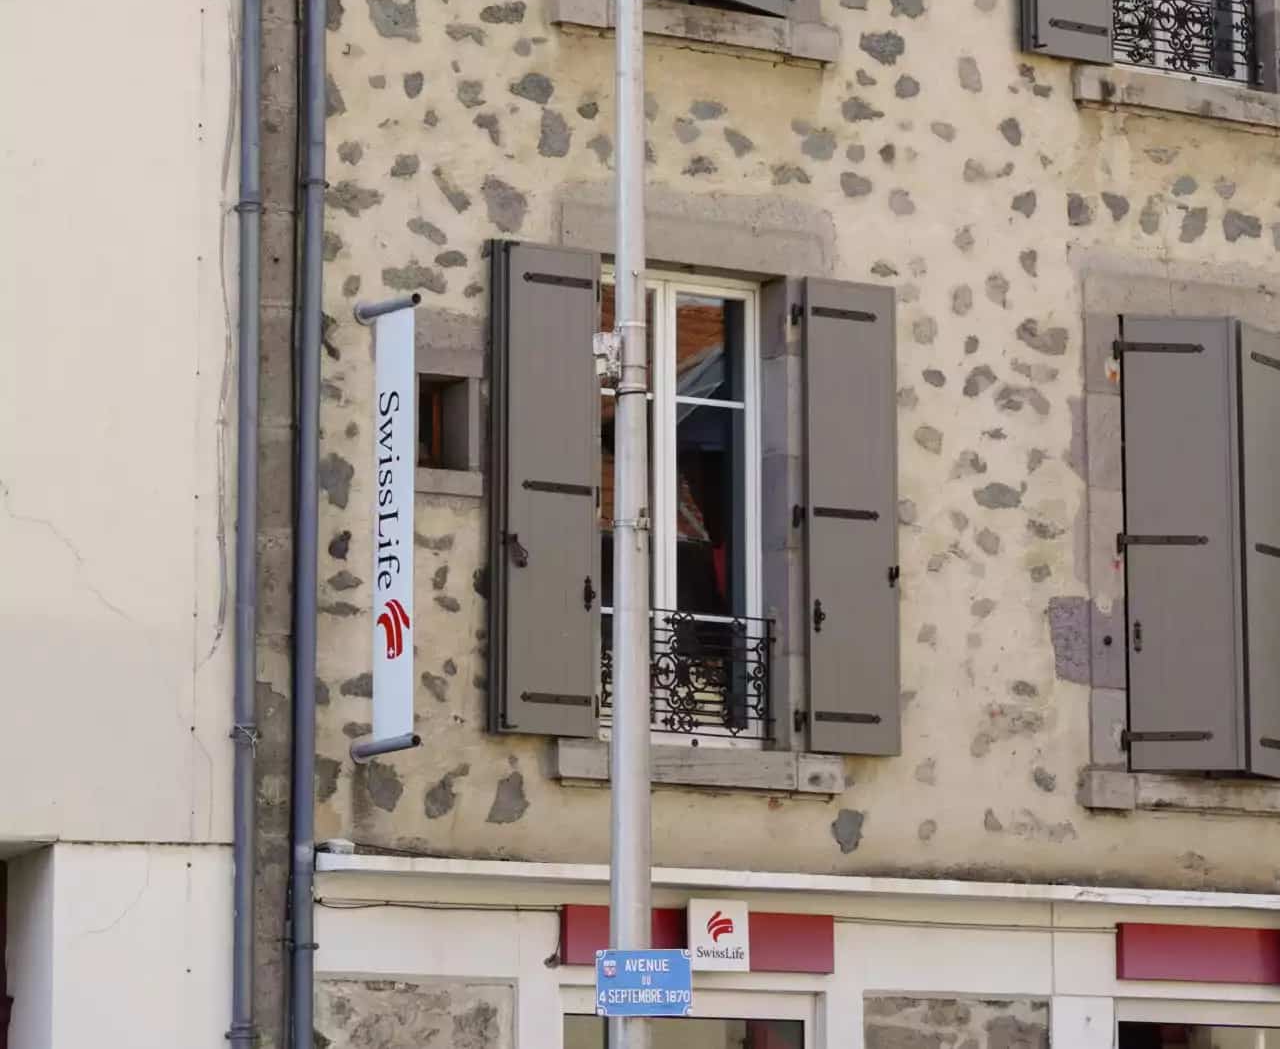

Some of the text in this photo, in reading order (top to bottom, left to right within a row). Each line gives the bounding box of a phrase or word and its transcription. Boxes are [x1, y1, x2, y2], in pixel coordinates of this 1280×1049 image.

[378, 390, 400, 590] SwissLife
[696, 945, 744, 960] SwissLife
[624, 958, 670, 972] AVENUE
[599, 989, 691, 1004] 4 SEPTEMBRE 1870
